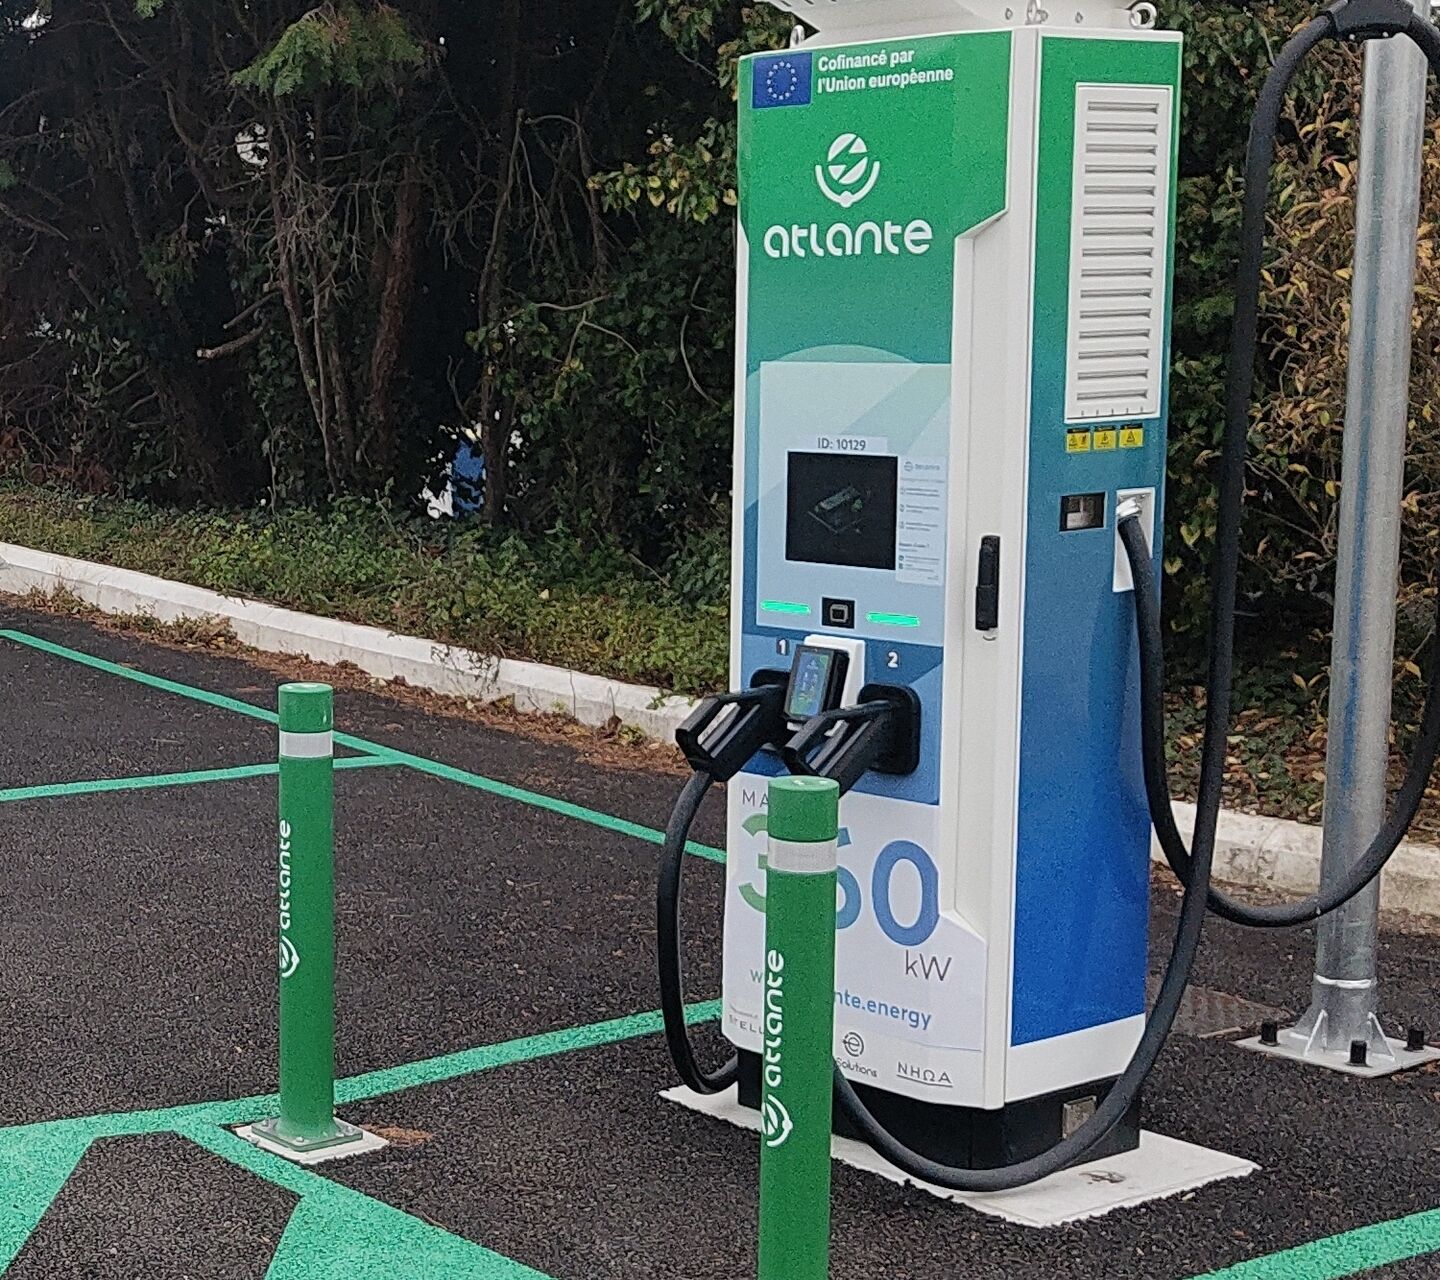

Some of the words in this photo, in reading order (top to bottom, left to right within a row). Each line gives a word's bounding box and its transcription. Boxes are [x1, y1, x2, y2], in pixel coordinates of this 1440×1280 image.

[817, 49, 887, 72] Cofinancé
[889, 49, 915, 68] par
[817, 75, 866, 94] l'Union
[868, 67, 954, 89] européenne
[763, 219, 933, 258] atlante
[817, 437, 834, 450] ID:
[836, 439, 867, 452] 10129
[778, 639, 787, 656] 1
[887, 652, 899, 669] 2
[741, 788, 769, 808] MA
[279, 819, 291, 930] atlante
[905, 949, 952, 982] kW
[764, 949, 785, 1087] atlante
